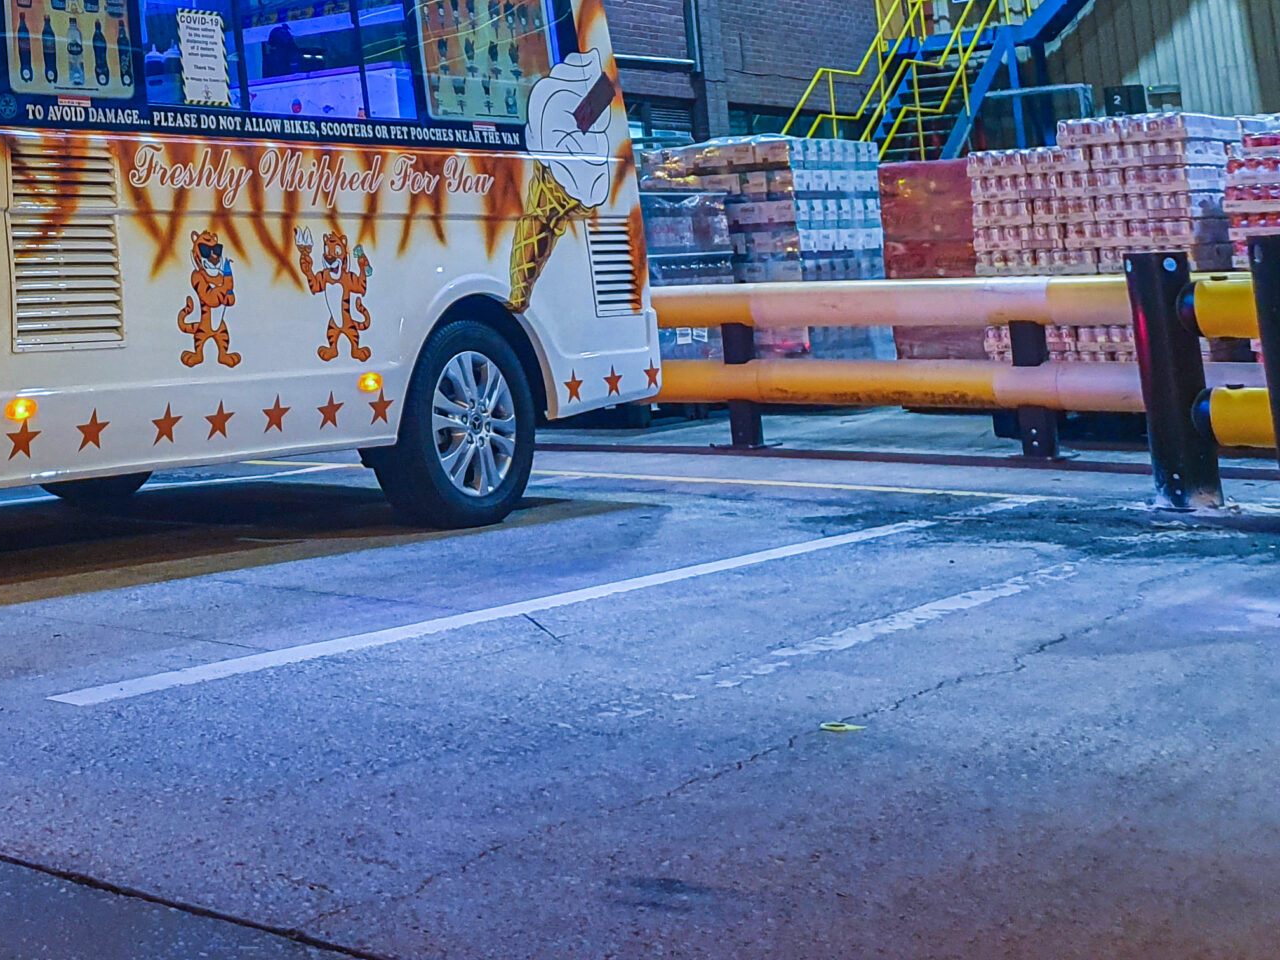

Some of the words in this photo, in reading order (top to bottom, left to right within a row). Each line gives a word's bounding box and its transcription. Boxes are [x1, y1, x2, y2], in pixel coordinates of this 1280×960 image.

[180, 15, 219, 26] COVID-19
[1113, 95, 1121, 105] 2
[26, 104, 44, 120] TO
[48, 106, 85, 122] AVOID
[153, 111, 198, 128] PLEASE
[200, 114, 216, 130] DO
[219, 116, 242, 132] NOT
[244, 118, 281, 134] ALLOW
[283, 119, 320, 137] BIKES,
[320, 122, 372, 137] SCOOTERS
[375, 125, 389, 139] OR
[390, 126, 409, 140] PET
[410, 127, 454, 142] POOCHES
[455, 129, 481, 143] NEAR
[482, 130, 501, 144] THE
[501, 132, 520, 145] VAN
[129, 144, 253, 208] Freshly
[259, 148, 383, 208] Whipped
[390, 154, 439, 194] For
[443, 155, 495, 195] You
